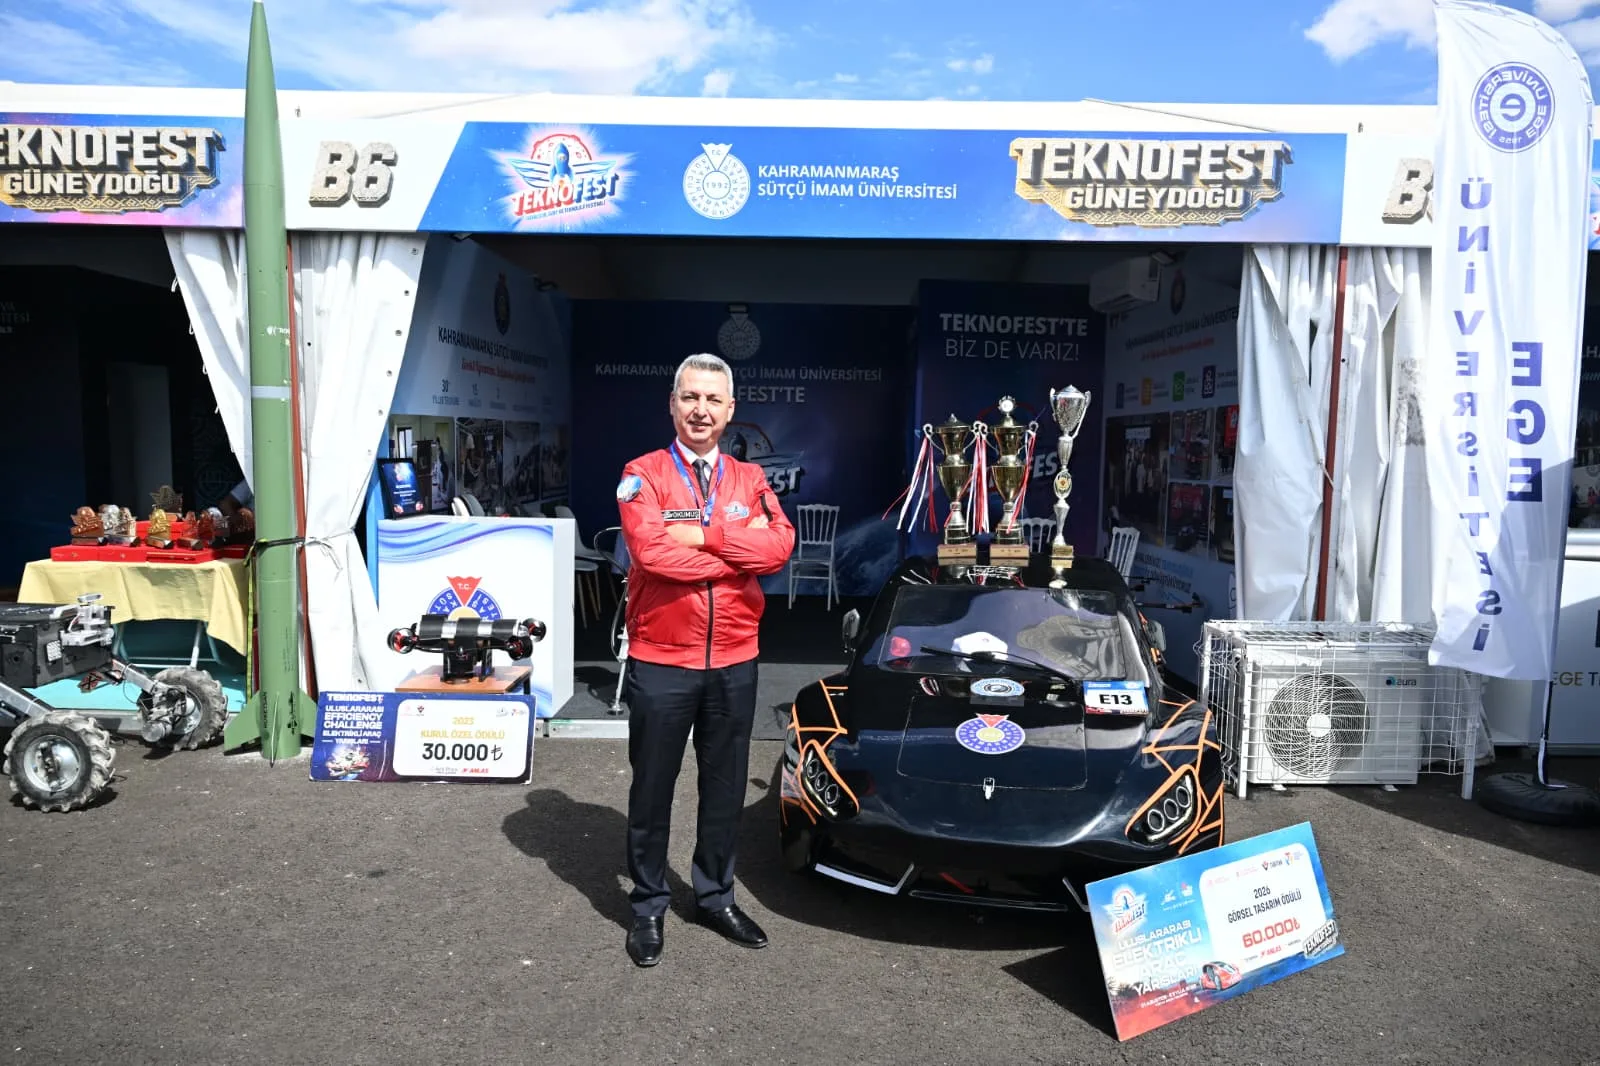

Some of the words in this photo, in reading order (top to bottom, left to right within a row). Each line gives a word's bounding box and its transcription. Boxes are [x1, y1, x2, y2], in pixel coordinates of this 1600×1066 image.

[0, 126, 222, 172] KNOFEST
[1013, 138, 1289, 181] TEKNOFEST
[3, 169, 181, 195] GÜNEYDOĞU
[310, 140, 397, 208] B6
[757, 165, 900, 182] KAHRAMANMARAŞ
[512, 174, 619, 216] TEKNOFEST
[757, 181, 807, 200] SÜTÇÜ
[811, 180, 854, 197] İMAM
[858, 181, 957, 200] ÜNİVERSİTESİ
[1064, 183, 1244, 210] GÜNEYDOĞU
[1381, 158, 1433, 224] B
[939, 313, 1089, 337] TEKNOFEST'TE
[945, 335, 979, 358] BİZ
[984, 340, 1011, 359] DE
[1016, 340, 1080, 361] VARIZ!
[760, 367, 795, 380] İMAM
[799, 365, 882, 382] ÜNİVERSİTESİ
[736, 384, 806, 403] FEST'TE
[1099, 694, 1133, 705] E13
[323, 720, 383, 729] CHALLENGE
[324, 711, 384, 721] EFFICIENCY
[422, 743, 489, 761] 30.000
[1253, 885, 1271, 899] 2026
[1227, 905, 1254, 923] GÖRSEL
